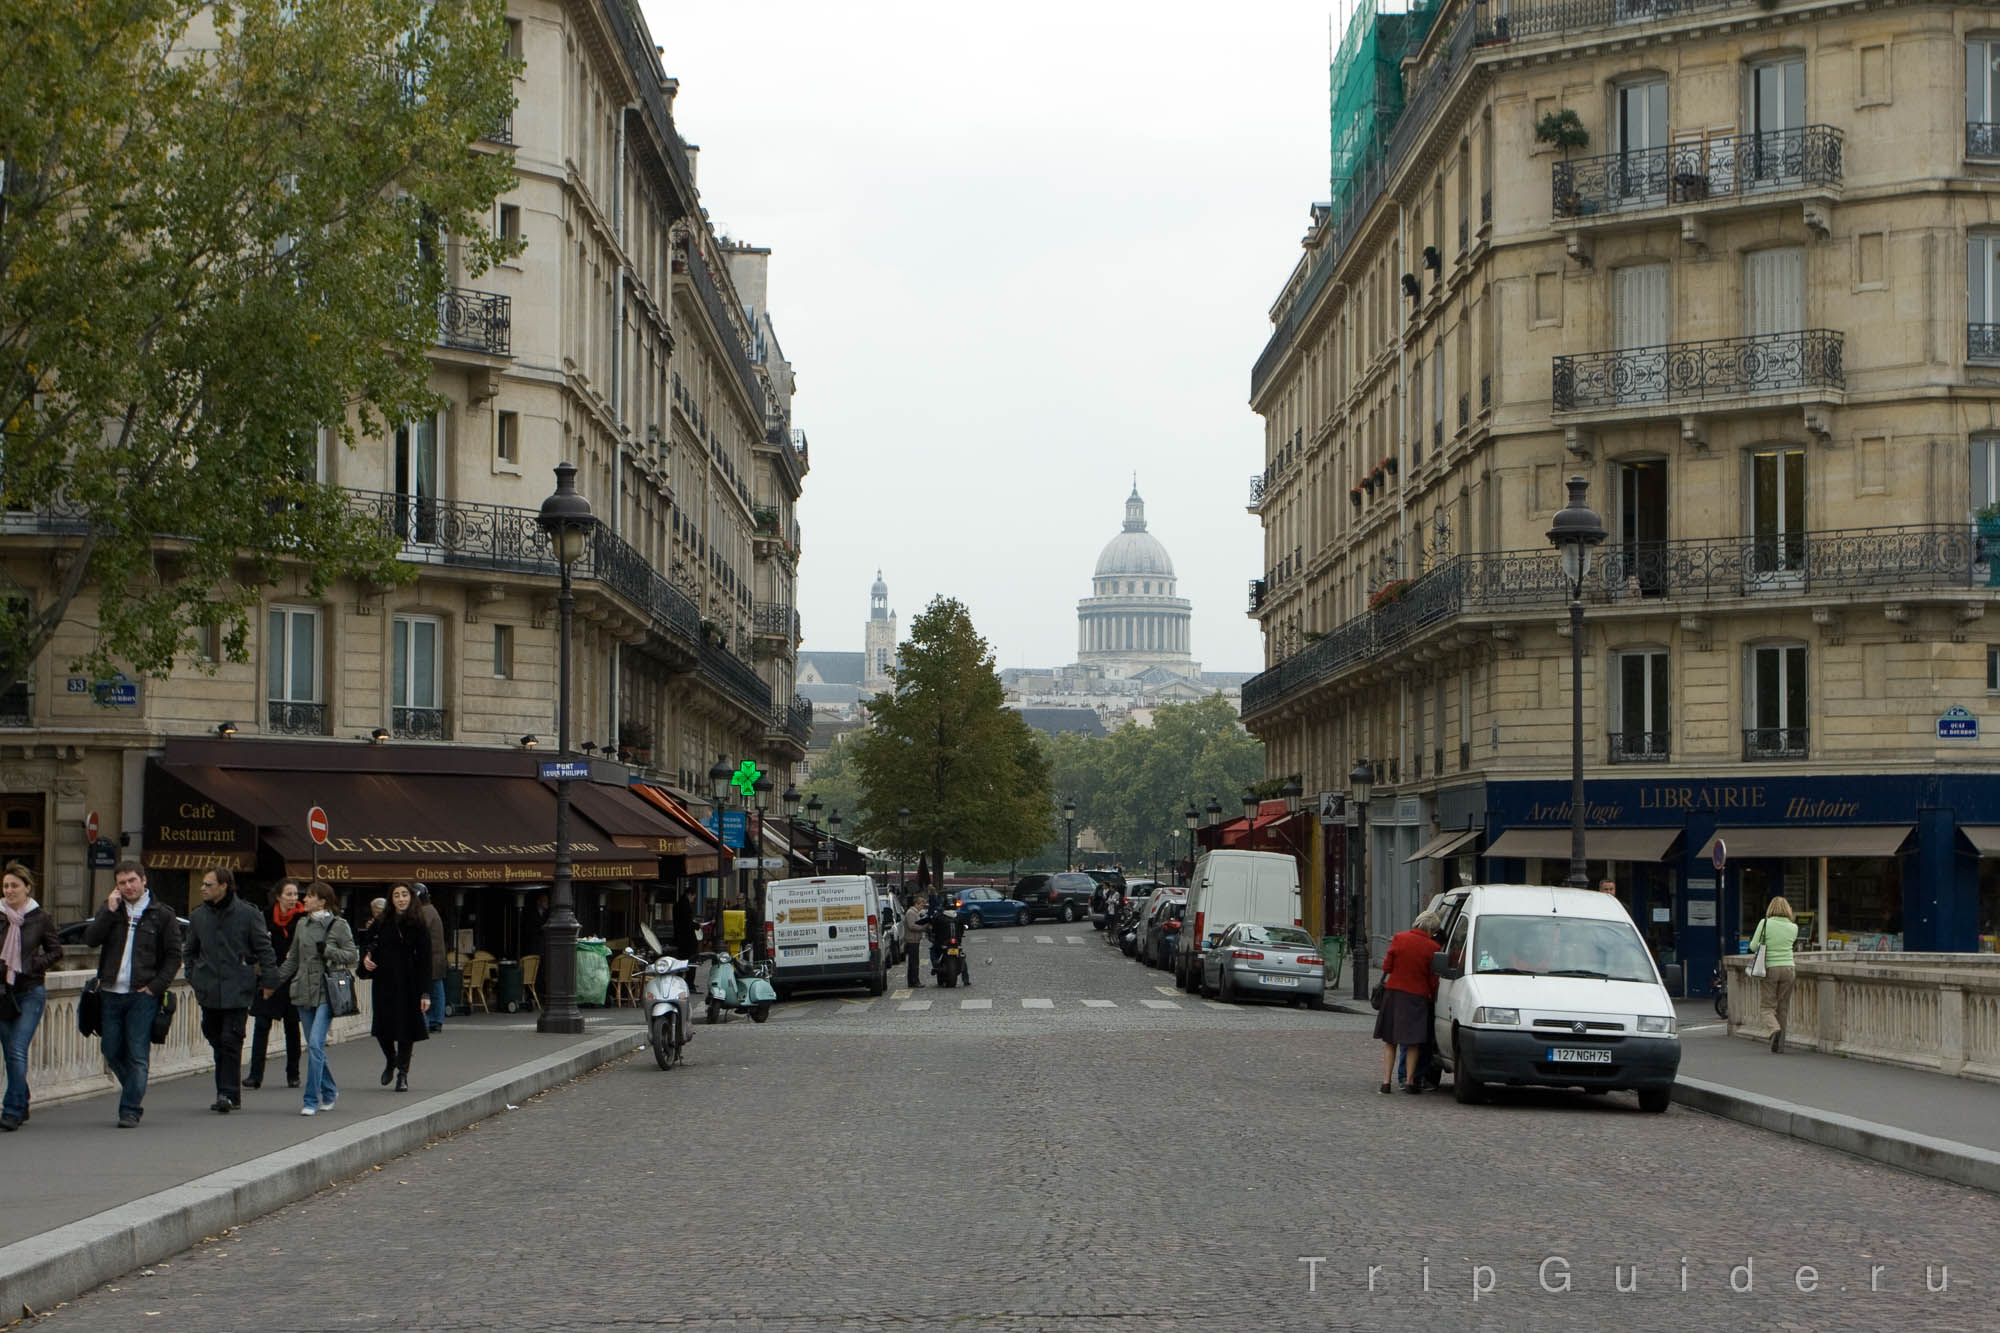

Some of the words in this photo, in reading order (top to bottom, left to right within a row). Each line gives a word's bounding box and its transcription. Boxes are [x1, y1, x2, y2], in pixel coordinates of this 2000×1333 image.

[69, 679, 84, 691] 33
[561, 769, 588, 777] PHILIPPE
[1639, 786, 1767, 809] LIBRAIRIE
[179, 802, 216, 818] Café
[1524, 800, 1624, 824] Archlogie
[1783, 796, 1861, 819] Histoire
[160, 826, 236, 841] Restaurant
[326, 838, 362, 852] LE
[150, 854, 170, 868] LE
[174, 851, 241, 869] LUTÉTIA
[316, 865, 350, 880] Café
[416, 868, 449, 880] Glaces
[453, 869, 462, 880] et
[466, 867, 502, 880] Sorbets
[571, 863, 633, 879] Restaurant
[1557, 1050, 1575, 1061] 127
[1576, 1050, 1596, 1062] NGH
[1597, 1051, 1610, 1062] 75
